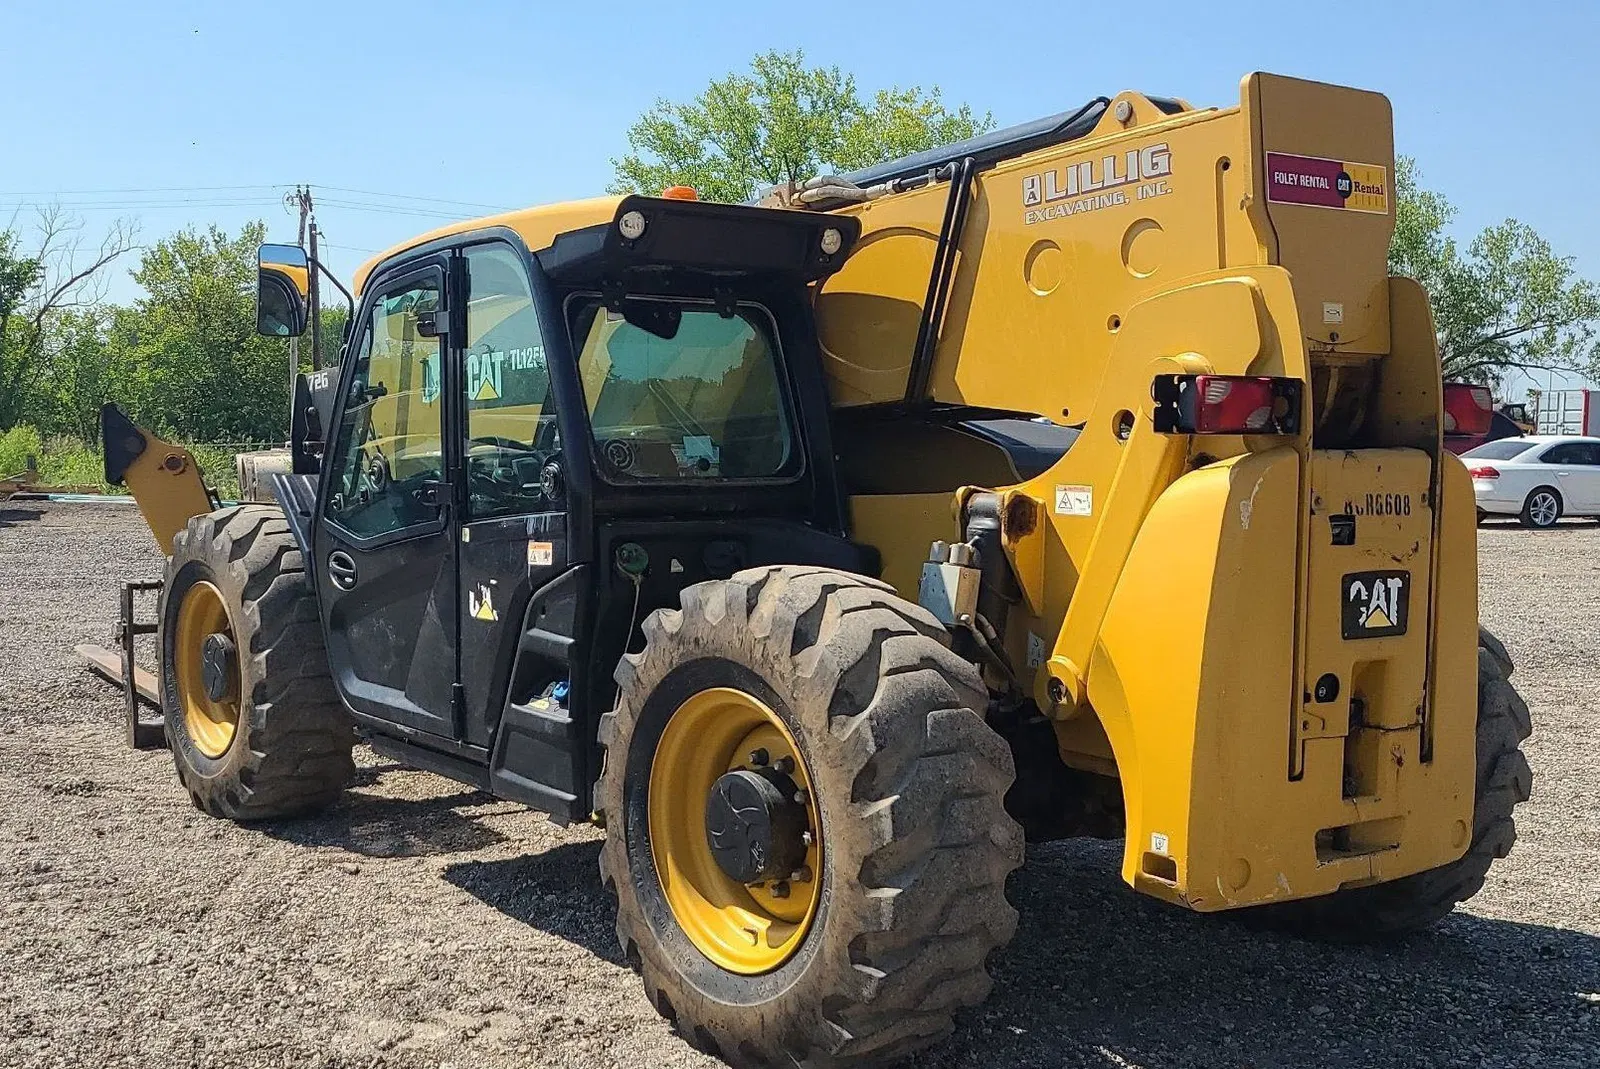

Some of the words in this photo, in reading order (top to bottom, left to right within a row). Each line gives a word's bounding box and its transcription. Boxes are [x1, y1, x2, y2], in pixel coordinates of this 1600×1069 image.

[1044, 143, 1172, 203] LILLIG
[1274, 171, 1299, 186] FOLEY
[1300, 174, 1330, 190] RENTAL
[1337, 178, 1350, 191] CAT
[1353, 181, 1384, 195] Rental
[1025, 191, 1130, 225] EXCAVATING,
[1136, 181, 1173, 201] INC.
[467, 351, 504, 401] CAT
